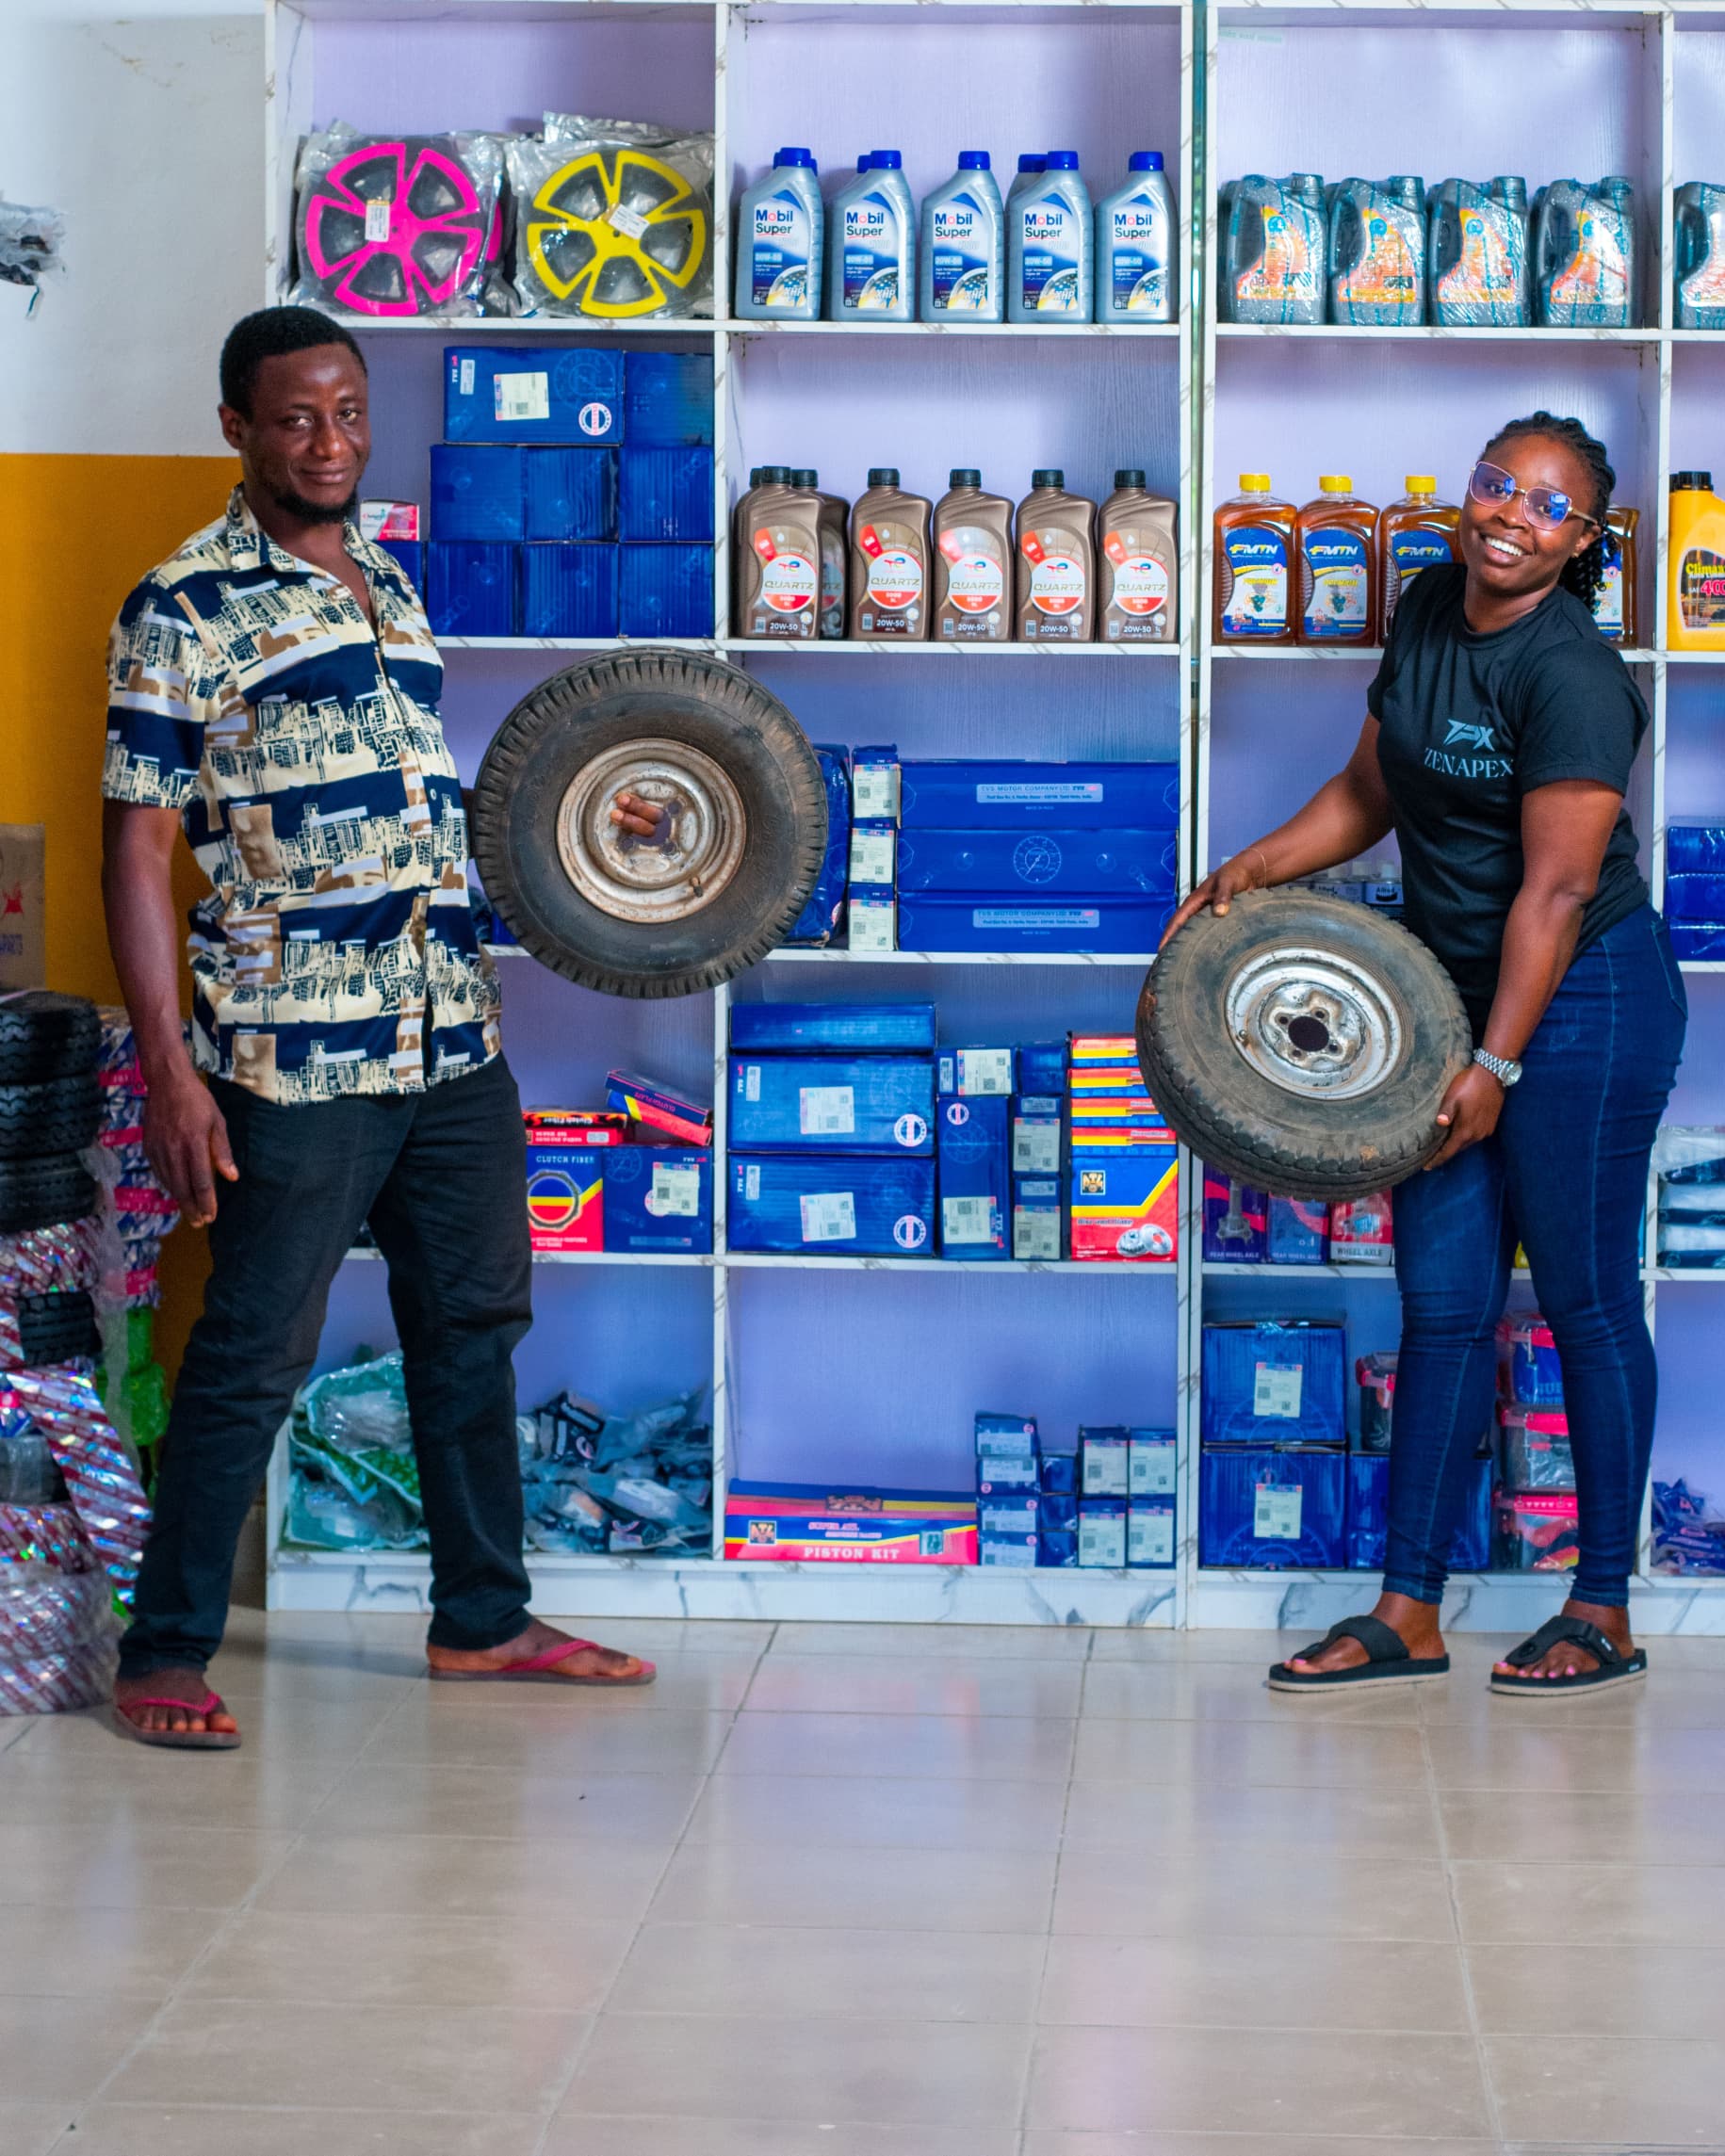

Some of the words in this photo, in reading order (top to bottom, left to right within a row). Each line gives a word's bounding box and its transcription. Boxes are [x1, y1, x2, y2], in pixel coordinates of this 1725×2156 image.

[756, 209, 793, 222] Mobil
[846, 212, 885, 224] Mobil
[935, 213, 972, 225] Mobil
[1024, 214, 1063, 225] Mobil
[1115, 214, 1152, 225] Mobil
[756, 222, 792, 235] Super
[846, 225, 883, 237] Super
[935, 226, 972, 237] Super
[1024, 227, 1062, 238] Super
[1115, 227, 1151, 238] Super
[765, 580, 815, 590] QUARTZ
[871, 576, 920, 587] QUARTZ
[951, 581, 1001, 591] QUARTZ
[1033, 583, 1083, 592] QUARTZ
[1116, 584, 1166, 592] QUARTZ
[770, 622, 799, 630] 20W-50
[876, 619, 905, 627] 20W-50
[1040, 624, 1068, 633] 20W-50
[1123, 625, 1152, 634] 20W-50
[1424, 747, 1513, 778] ZENAPEX
[1338, 1246, 1362, 1256] WHEEL
[1365, 1248, 1383, 1256] AXLE
[804, 1547, 864, 1559] PISTON
[871, 1548, 900, 1560] KIT
